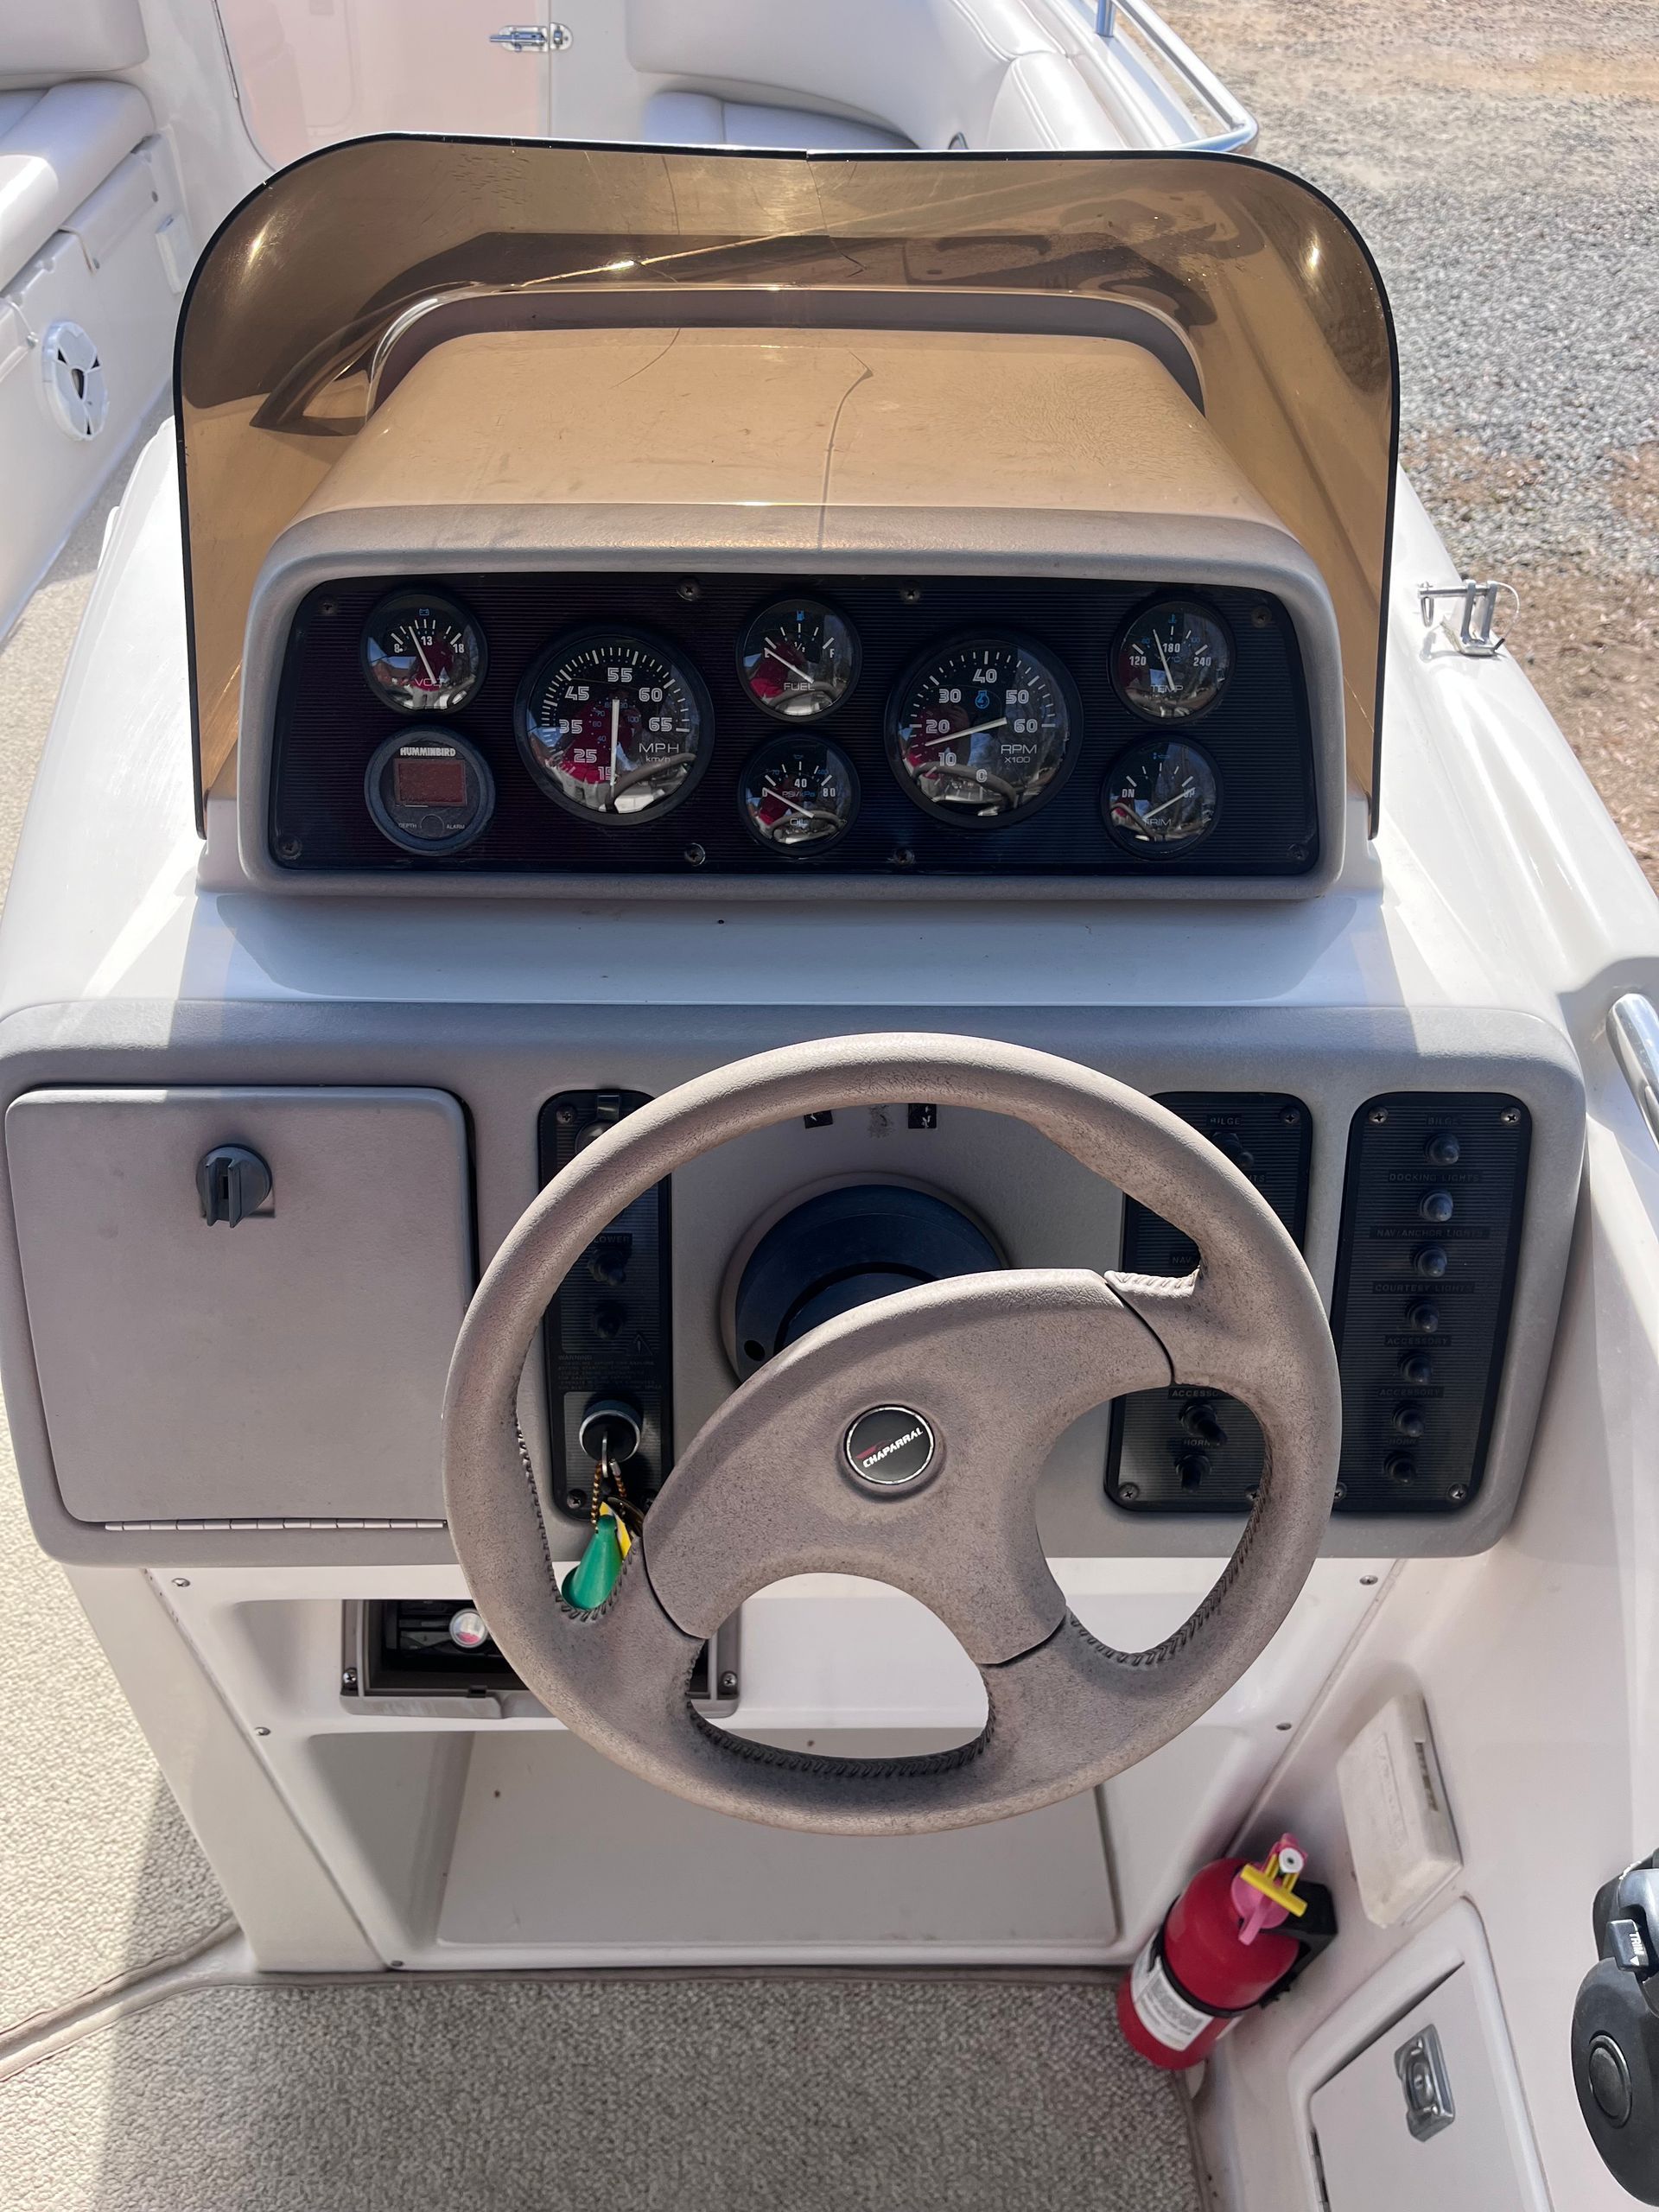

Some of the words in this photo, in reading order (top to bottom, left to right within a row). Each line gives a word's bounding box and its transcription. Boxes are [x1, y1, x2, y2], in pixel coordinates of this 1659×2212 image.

[421, 636, 433, 646] 13
[394, 643, 401, 653] 8
[453, 644, 465, 654] 18
[830, 648, 836, 658] F
[1162, 642, 1181, 653] 180
[1128, 656, 1147, 666] 120
[1192, 657, 1212, 667] 240
[607, 666, 633, 683] 55
[972, 668, 998, 684] 40
[783, 682, 816, 691] FUEL
[1150, 684, 1184, 693] TEMP
[564, 685, 590, 702] 45
[638, 687, 664, 702] 60
[938, 688, 962, 703] 30
[1005, 689, 1030, 704] 50
[558, 719, 583, 734] 35
[648, 716, 673, 733] 65
[925, 718, 950, 734] 20
[1014, 718, 1038, 734] 60
[399, 747, 456, 757] HUMMINBIRD
[639, 742, 679, 753] MPH
[1000, 744, 1038, 754] RPM
[573, 748, 598, 764] 25
[938, 752, 957, 766] 10
[597, 766, 613, 781] 15
[976, 768, 988, 783] 0
[794, 778, 807, 788] 40
[823, 787, 836, 798] 80
[1122, 788, 1135, 798] DN
[1184, 787, 1196, 798] UP
[790, 817, 809, 826] OIL
[1210, 1116, 1241, 1126] BILGE
[1389, 1173, 1438, 1183] DOCKING
[1442, 1173, 1480, 1183] LIGHTS
[594, 1235, 629, 1244] LOWER
[862, 1427, 924, 1468] CHAPARRAL
[1629, 1931, 1645, 1955] TRIM
